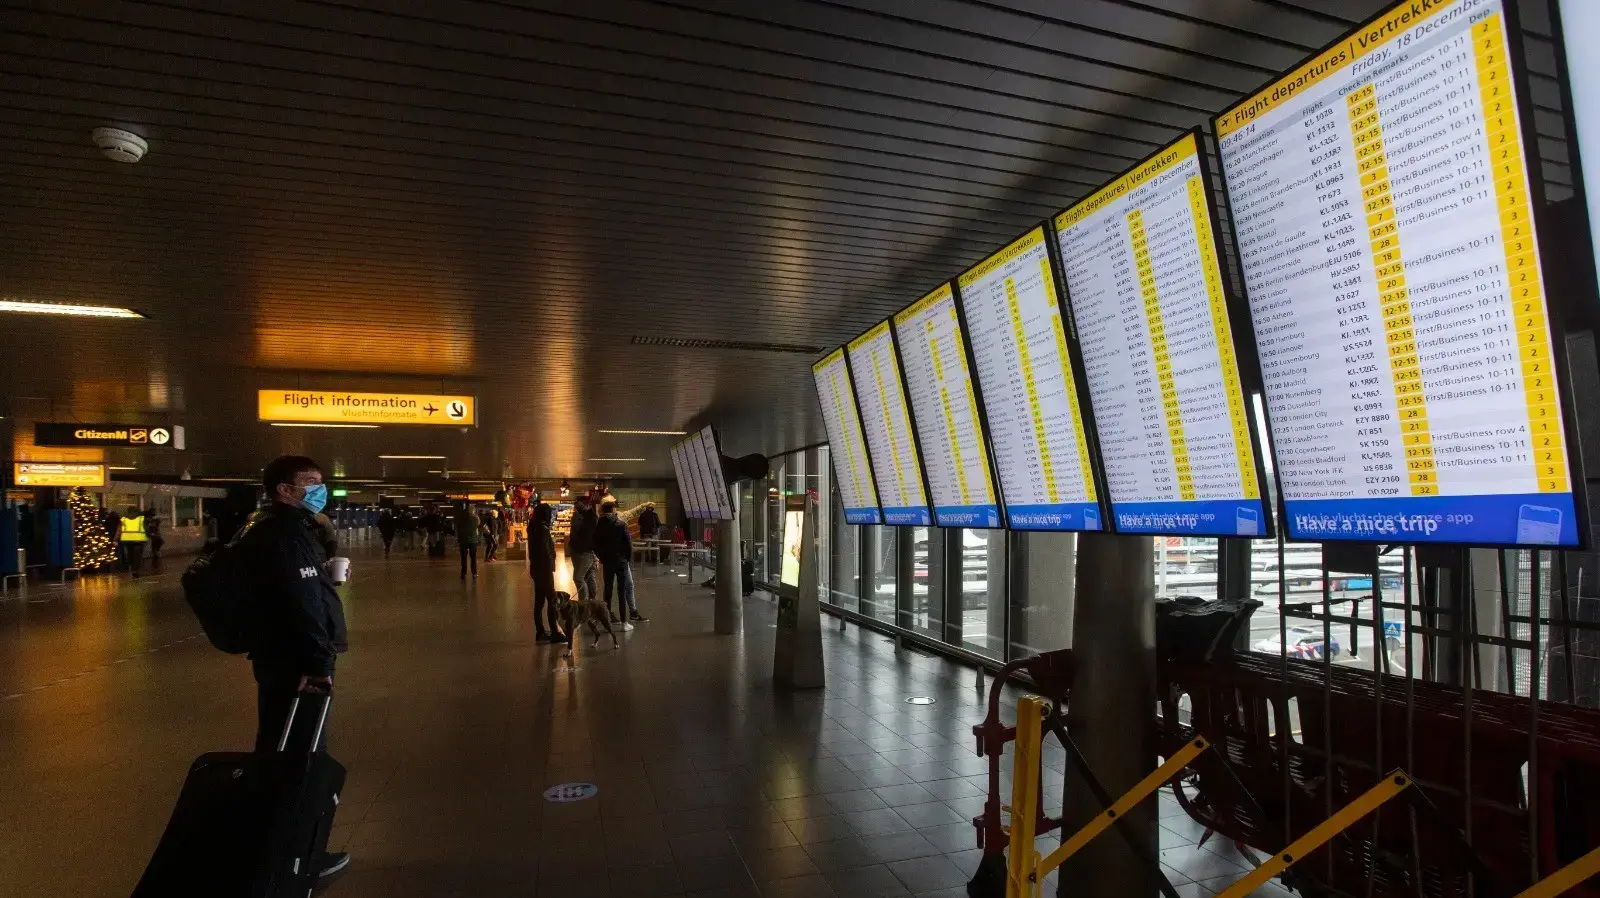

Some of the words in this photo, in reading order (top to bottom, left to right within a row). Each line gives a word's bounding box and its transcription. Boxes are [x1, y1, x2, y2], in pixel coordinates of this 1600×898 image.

[1349, 86, 1371, 104] 12-15
[1374, 53, 1435, 91] First/Business
[1438, 35, 1465, 57] 10-11
[1352, 49, 1392, 75] Friday,
[1397, 34, 1411, 47] 18
[1235, 97, 1268, 123] Flight
[1272, 50, 1346, 101] departures
[1240, 128, 1275, 150] Destination
[1302, 101, 1323, 118] Flight
[1338, 75, 1371, 96] Check-in
[1372, 53, 1409, 77] Remarks
[1354, 113, 1376, 131] 12-15
[1379, 83, 1440, 119] First/Business
[1443, 66, 1469, 87] 10-11
[1243, 149, 1283, 174] Copenhagen
[1352, 100, 1374, 118] 12-15
[1377, 68, 1437, 105] First/Business
[1440, 50, 1467, 72] 10-11
[1356, 127, 1378, 145] 12-15
[1381, 98, 1442, 133] First/Business
[1445, 82, 1472, 102] 10-11
[1221, 124, 1256, 150] 09:46:14
[1358, 141, 1380, 158] 12-15
[1383, 113, 1444, 147] First/Business
[1447, 97, 1474, 117] 10-11
[1326, 173, 1344, 187] 0963
[1361, 155, 1383, 172] 12-15
[1386, 128, 1446, 160] First/Business
[1450, 113, 1476, 132] 10-11
[1159, 159, 1194, 184] December
[1317, 194, 1326, 204] TP
[1327, 188, 1341, 200] 673
[1388, 143, 1449, 174] First/Business
[1451, 134, 1471, 148] row
[1365, 182, 1387, 198] 12-15
[1390, 158, 1451, 188] First/Business
[1454, 144, 1481, 162] 10-11
[1065, 207, 1085, 224] Flight
[1086, 184, 1125, 211] departures
[1130, 150, 1178, 184] Vertrekken
[1367, 196, 1389, 211] 12-15
[1392, 173, 1453, 202] First/Business
[1457, 159, 1483, 177] 10-11
[1394, 188, 1456, 215] First/Business
[1459, 174, 1485, 192] 10-11
[1372, 223, 1394, 238] 12-15
[1397, 202, 1458, 229] First/Business
[1461, 189, 1488, 206] 10-11
[1343, 249, 1361, 261] 5106
[1379, 239, 1390, 249] 28
[1378, 264, 1400, 277] 12-15
[1403, 246, 1464, 270] First/Business
[1468, 235, 1494, 250] 10-11
[1381, 252, 1392, 262] 18
[1335, 294, 1344, 303] A3
[1346, 290, 1360, 300] 627
[1386, 279, 1396, 289] 20
[1382, 290, 1405, 303] 12-15
[1408, 275, 1469, 296] First/Business
[1472, 264, 1499, 279] 10-11
[1384, 304, 1407, 316] 12-15
[1410, 289, 1471, 310] First/Business
[1474, 279, 1501, 294] 10-11
[1387, 317, 1409, 329] 12-15
[1412, 303, 1473, 323] First/Business
[1477, 294, 1503, 308] 10-11
[1389, 330, 1411, 342] 12-15
[1414, 318, 1476, 336] First/Business
[1479, 309, 1506, 322] 10-11
[1391, 343, 1413, 355] 12-15
[1416, 332, 1478, 349] First/Business
[1481, 324, 1508, 336] 10-11
[1393, 356, 1415, 367] 12-15
[1418, 346, 1480, 363] First/Business
[1483, 338, 1510, 351] 10-11
[1395, 370, 1417, 380] 12-15
[1420, 360, 1482, 376] First/Business
[1485, 353, 1512, 365] 10-11
[1397, 383, 1419, 393] 12-15
[1422, 374, 1484, 389] First/Business
[1488, 367, 1514, 379] 10-11
[284, 394, 325, 408] Flight
[332, 395, 417, 408] information
[1399, 396, 1422, 405] 12-15
[1425, 388, 1486, 402] First/Business
[1490, 382, 1517, 393] 10-11
[1354, 416, 1369, 424] EZY
[1407, 409, 1417, 417] 28
[1368, 426, 1382, 434] 851
[1409, 422, 1419, 430] 21
[74, 430, 128, 439] CitizenM
[1371, 438, 1388, 446] 1550
[1431, 430, 1493, 441] First/Business
[1407, 447, 1430, 455] 12-15
[1433, 443, 1495, 454] First/Business
[1410, 460, 1432, 468] 12-15
[1435, 457, 1497, 466] First/Business
[1381, 474, 1399, 482] 2160
[1120, 516, 1144, 526] Have
[1296, 516, 1337, 530] Have
[1341, 519, 1353, 530] a
[1357, 515, 1394, 530] nice
[1400, 515, 1438, 535] trip
[1446, 513, 1474, 524] app
[299, 566, 318, 578] HH
